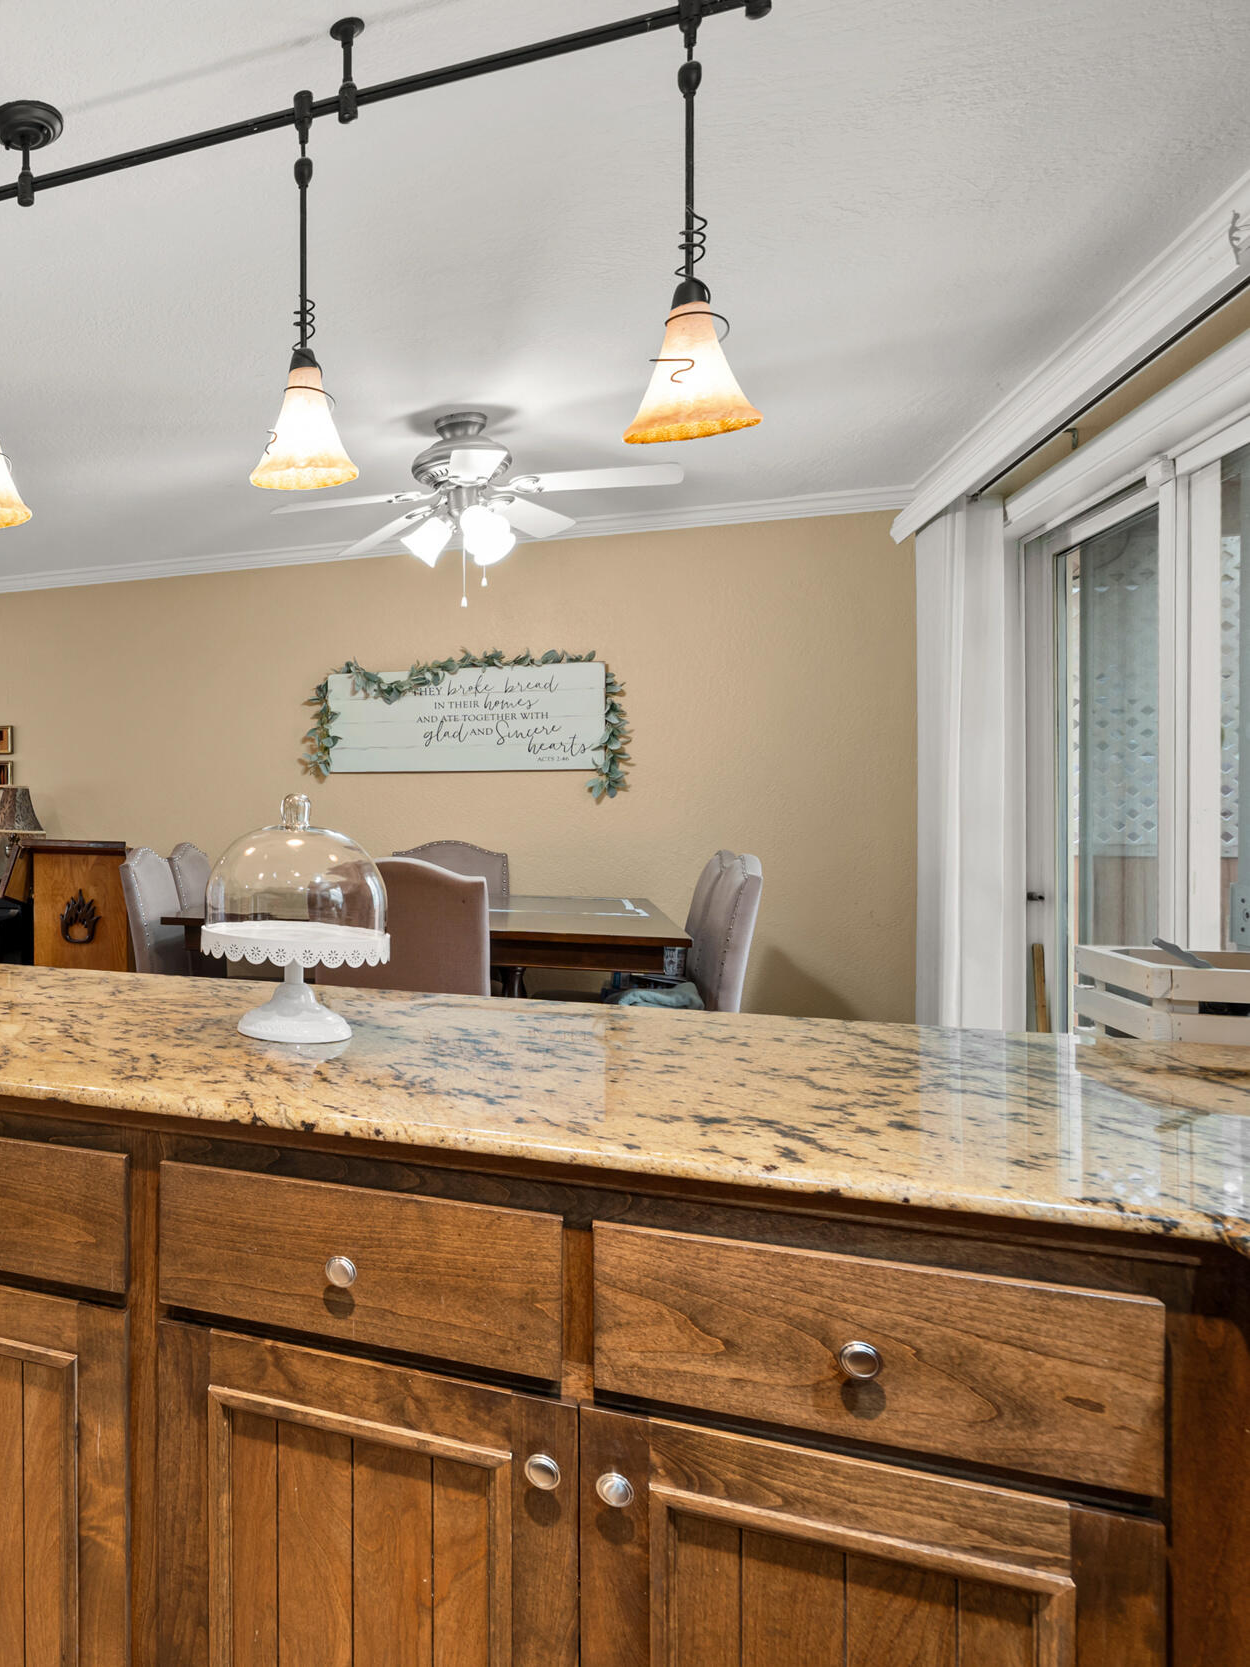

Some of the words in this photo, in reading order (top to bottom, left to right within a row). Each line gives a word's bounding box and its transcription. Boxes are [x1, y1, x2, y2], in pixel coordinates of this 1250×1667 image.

[447, 674, 494, 697] broke
[504, 674, 559, 694] bread
[434, 701, 445, 710] IN
[449, 700, 480, 710] THEIR
[483, 694, 541, 711] homes
[416, 715, 438, 724] AND
[441, 714, 461, 723] ATE
[461, 712, 517, 722] TOGETHER
[520, 711, 549, 720] WITH
[423, 720, 469, 748] glad
[469, 727, 493, 737] AND
[527, 733, 592, 757] hearts
